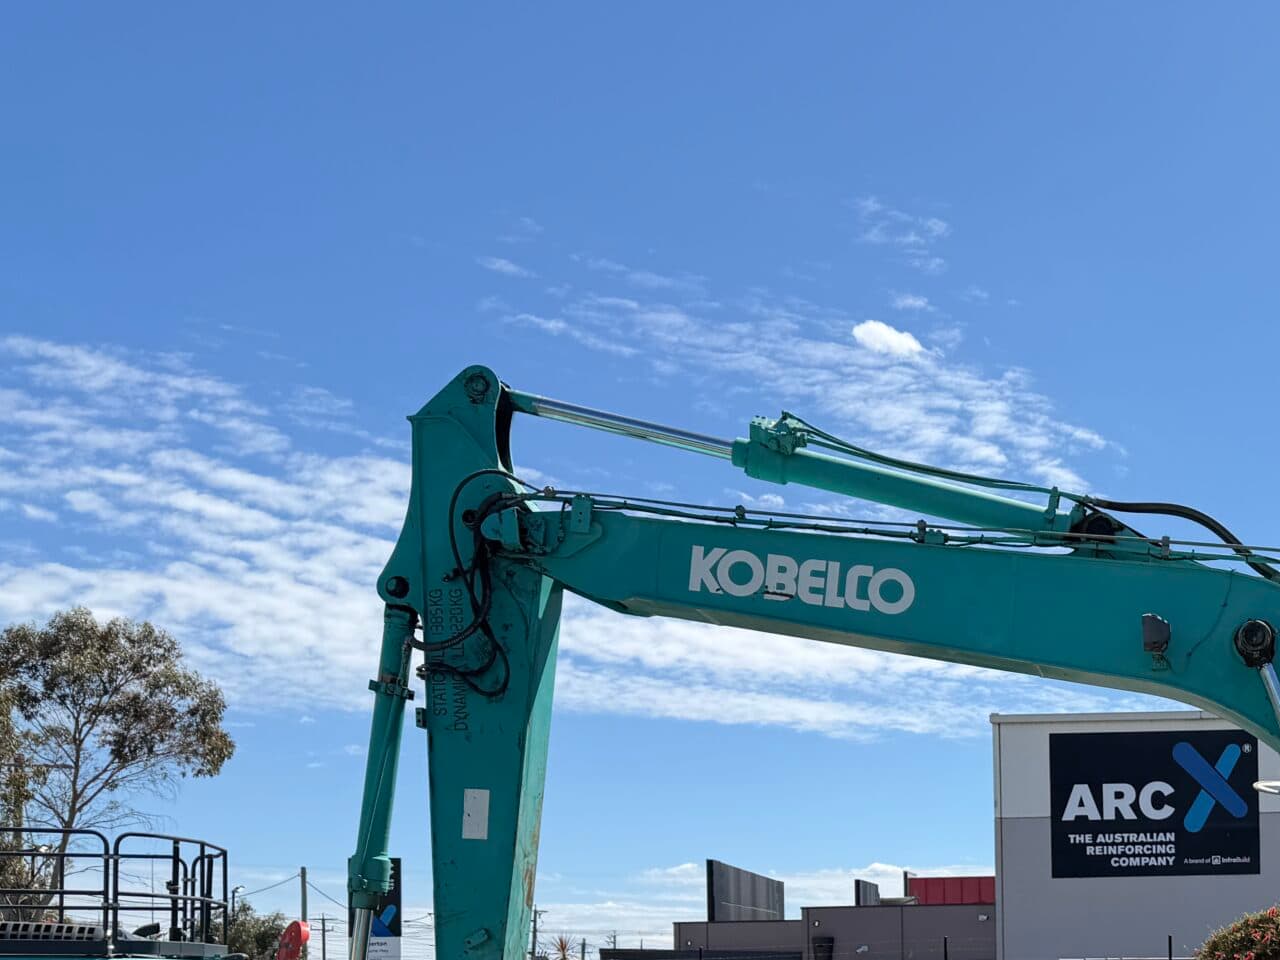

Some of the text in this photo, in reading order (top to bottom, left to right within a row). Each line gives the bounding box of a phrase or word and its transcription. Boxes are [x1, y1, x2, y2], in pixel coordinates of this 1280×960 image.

[688, 545, 915, 614] KOBELCO
[432, 670, 447, 716] STATIC
[1061, 781, 1175, 822] ARC
[1068, 832, 1175, 843] THE AUSTRALIAN
[1086, 844, 1175, 855] REINFORCING
[1110, 856, 1175, 867] COMPANY
